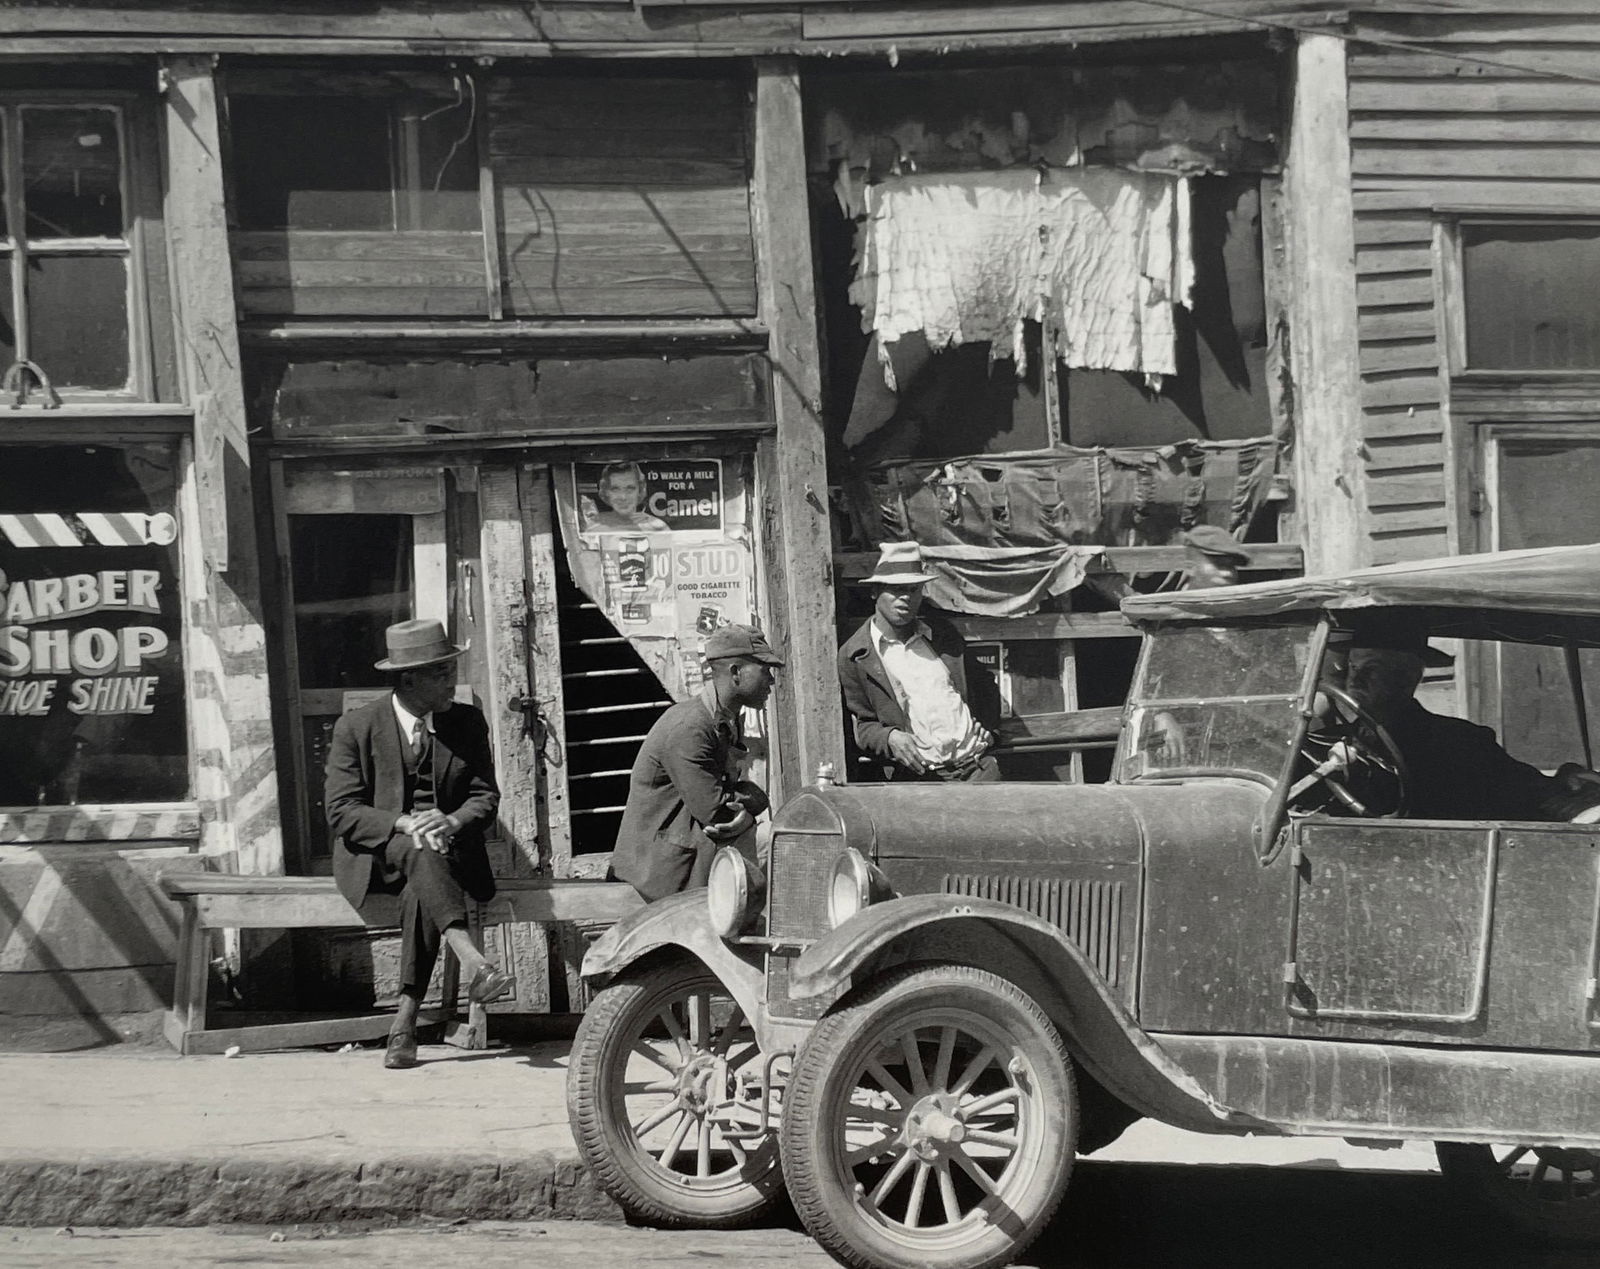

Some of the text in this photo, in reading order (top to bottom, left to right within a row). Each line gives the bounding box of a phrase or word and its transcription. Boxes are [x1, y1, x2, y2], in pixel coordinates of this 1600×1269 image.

[647, 470, 715, 480] I'D WALK A MILE
[668, 482, 695, 490] FOR A
[648, 491, 718, 517] Camel
[677, 550, 740, 577] STUD
[677, 581, 741, 591] GOOD CIGARETTE
[691, 591, 728, 599] TOBACCO
[0, 625, 168, 677] SHOP
[67, 676, 159, 715] SHINE
